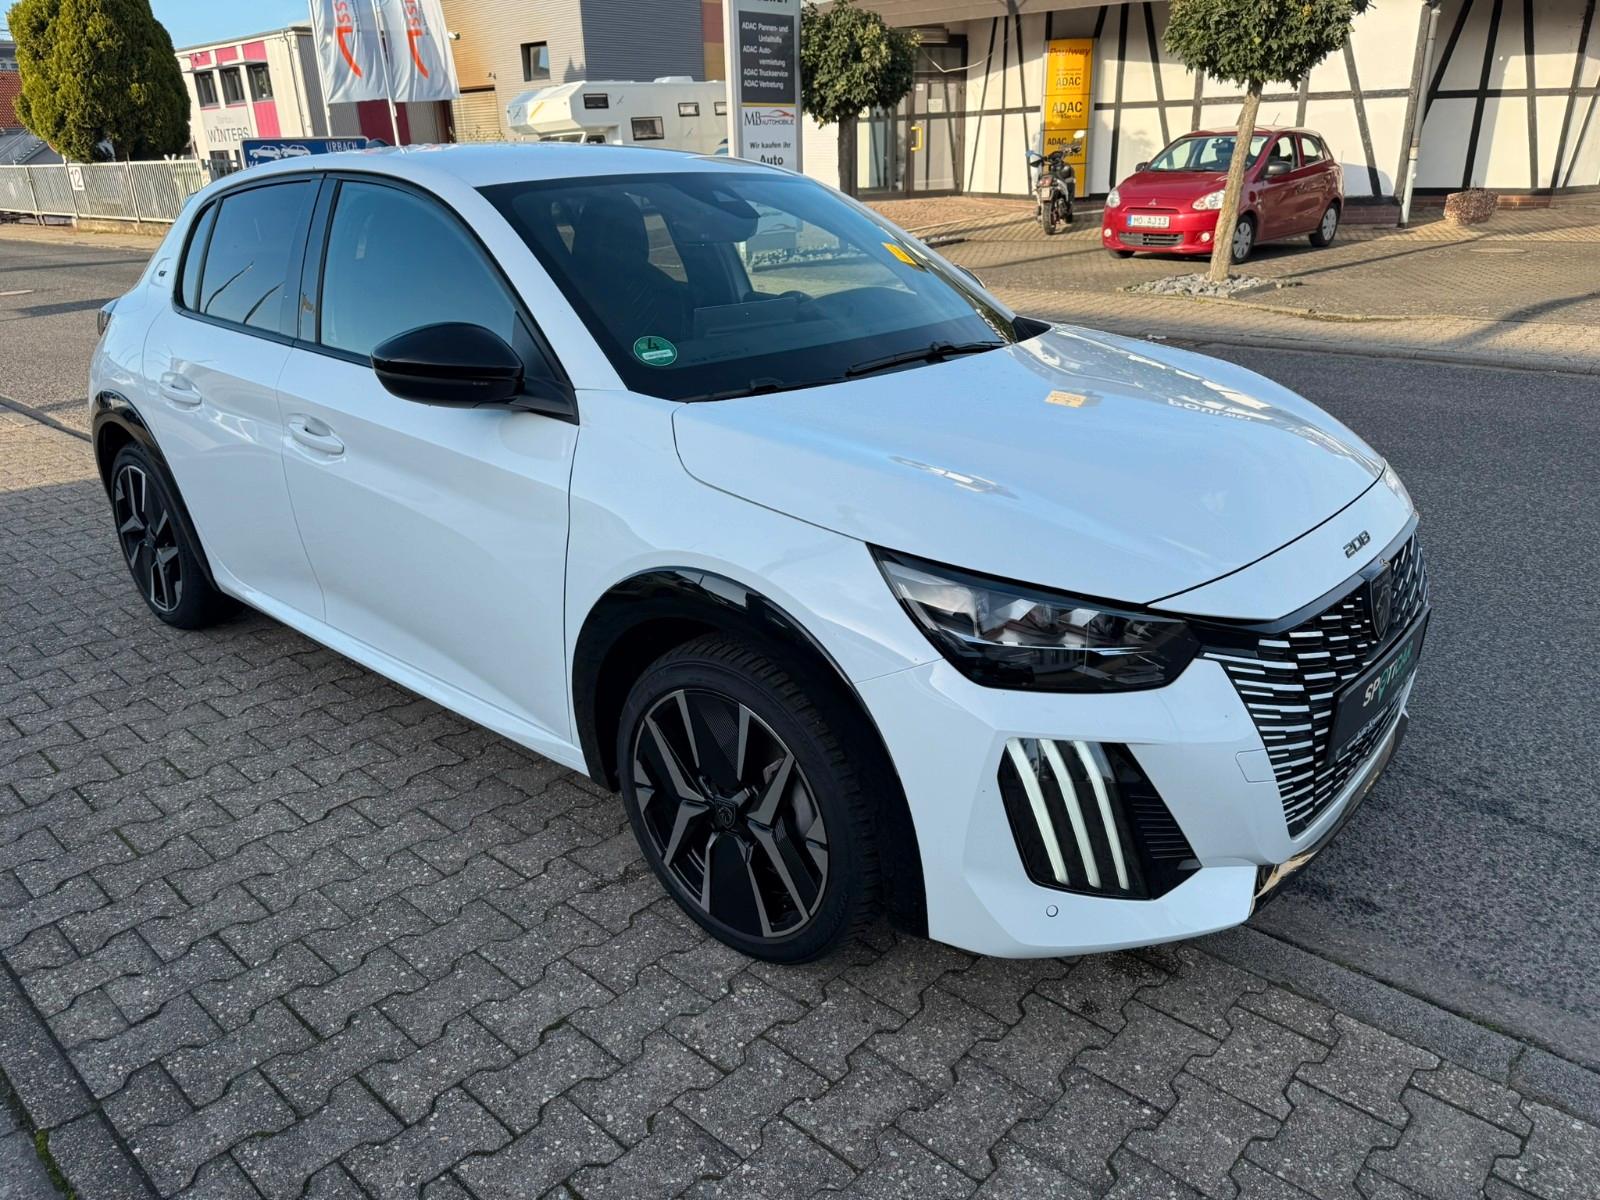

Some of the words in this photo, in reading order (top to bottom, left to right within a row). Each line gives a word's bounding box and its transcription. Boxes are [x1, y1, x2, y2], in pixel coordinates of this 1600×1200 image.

[742, 22, 757, 30] ADAC
[743, 45, 757, 53] ADAC
[759, 46, 772, 54] Auto-
[744, 68, 758, 76] ADAC
[1056, 77, 1081, 86] ADAC
[1052, 101, 1082, 113] ADAC
[744, 111, 761, 126] MB
[207, 126, 249, 143] WINTERS
[1047, 137, 1066, 146] ADAC
[760, 154, 784, 166] Auto
[70, 169, 83, 188] 12
[1342, 530, 1371, 559] 208
